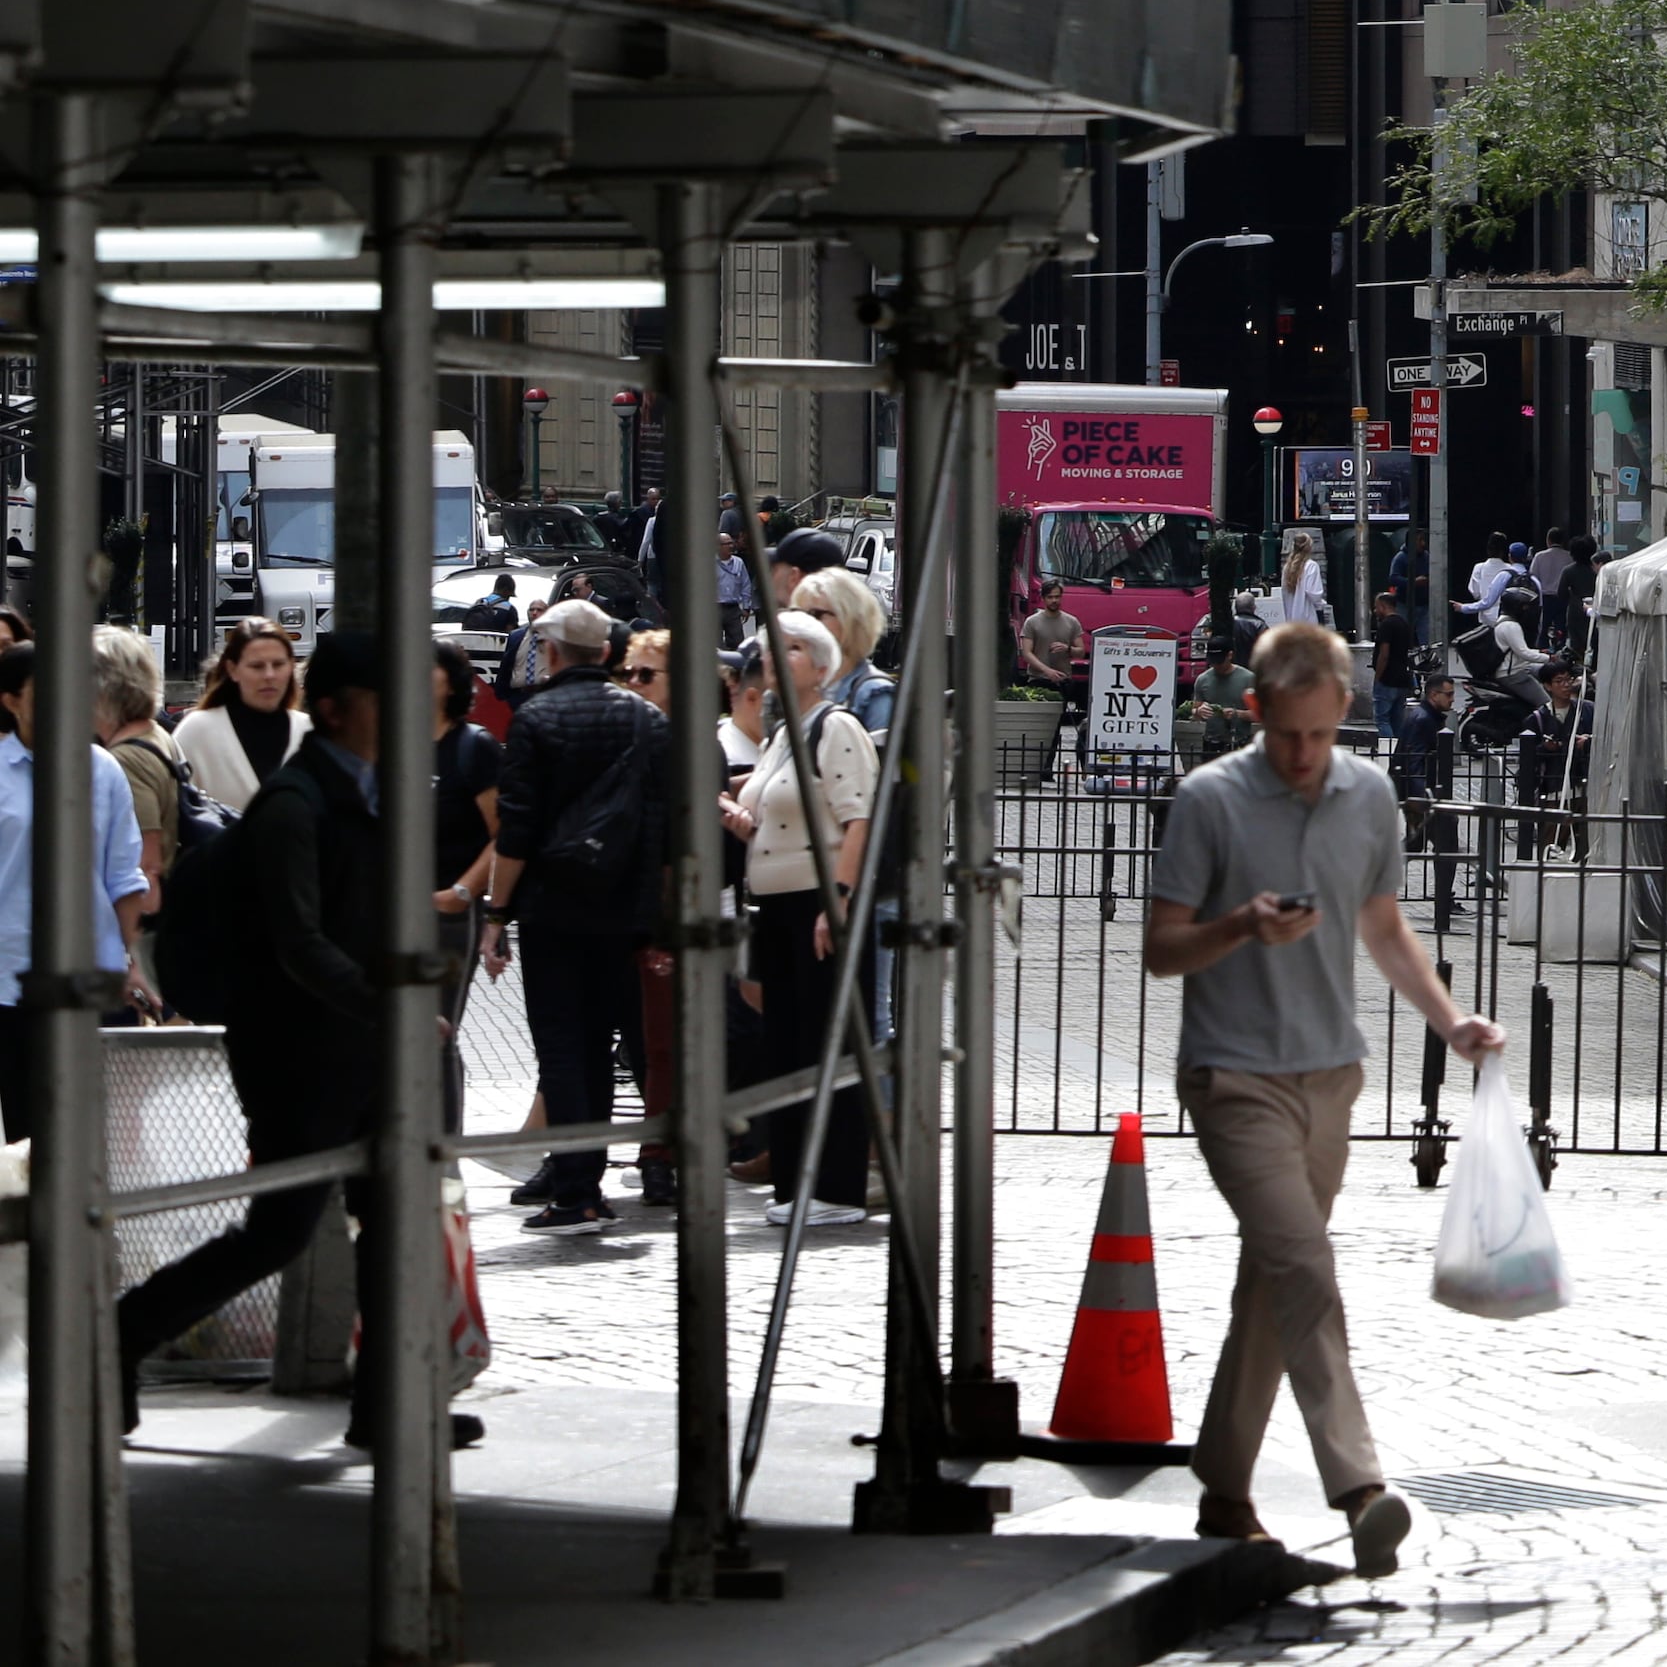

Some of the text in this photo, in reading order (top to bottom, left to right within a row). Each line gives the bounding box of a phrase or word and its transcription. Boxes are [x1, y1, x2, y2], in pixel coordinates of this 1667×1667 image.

[1456, 315, 1528, 336] Exchange Pl
[1026, 323, 1060, 370] JOE
[1064, 356, 1075, 370] &
[1397, 367, 1426, 381] ONE
[1420, 396, 1432, 409] NO
[1412, 413, 1439, 423] STANDING
[1062, 421, 1140, 441] PIECE
[1414, 427, 1437, 438] ANYTIME
[1062, 444, 1183, 466] OF CAKE
[1061, 468, 1183, 479] MOVING & STORAGE
[1103, 648, 1172, 658] Gifts & Souvenirs
[1111, 664, 1125, 689] I
[1103, 692, 1162, 718] NY
[1102, 720, 1159, 735] GIFTS
